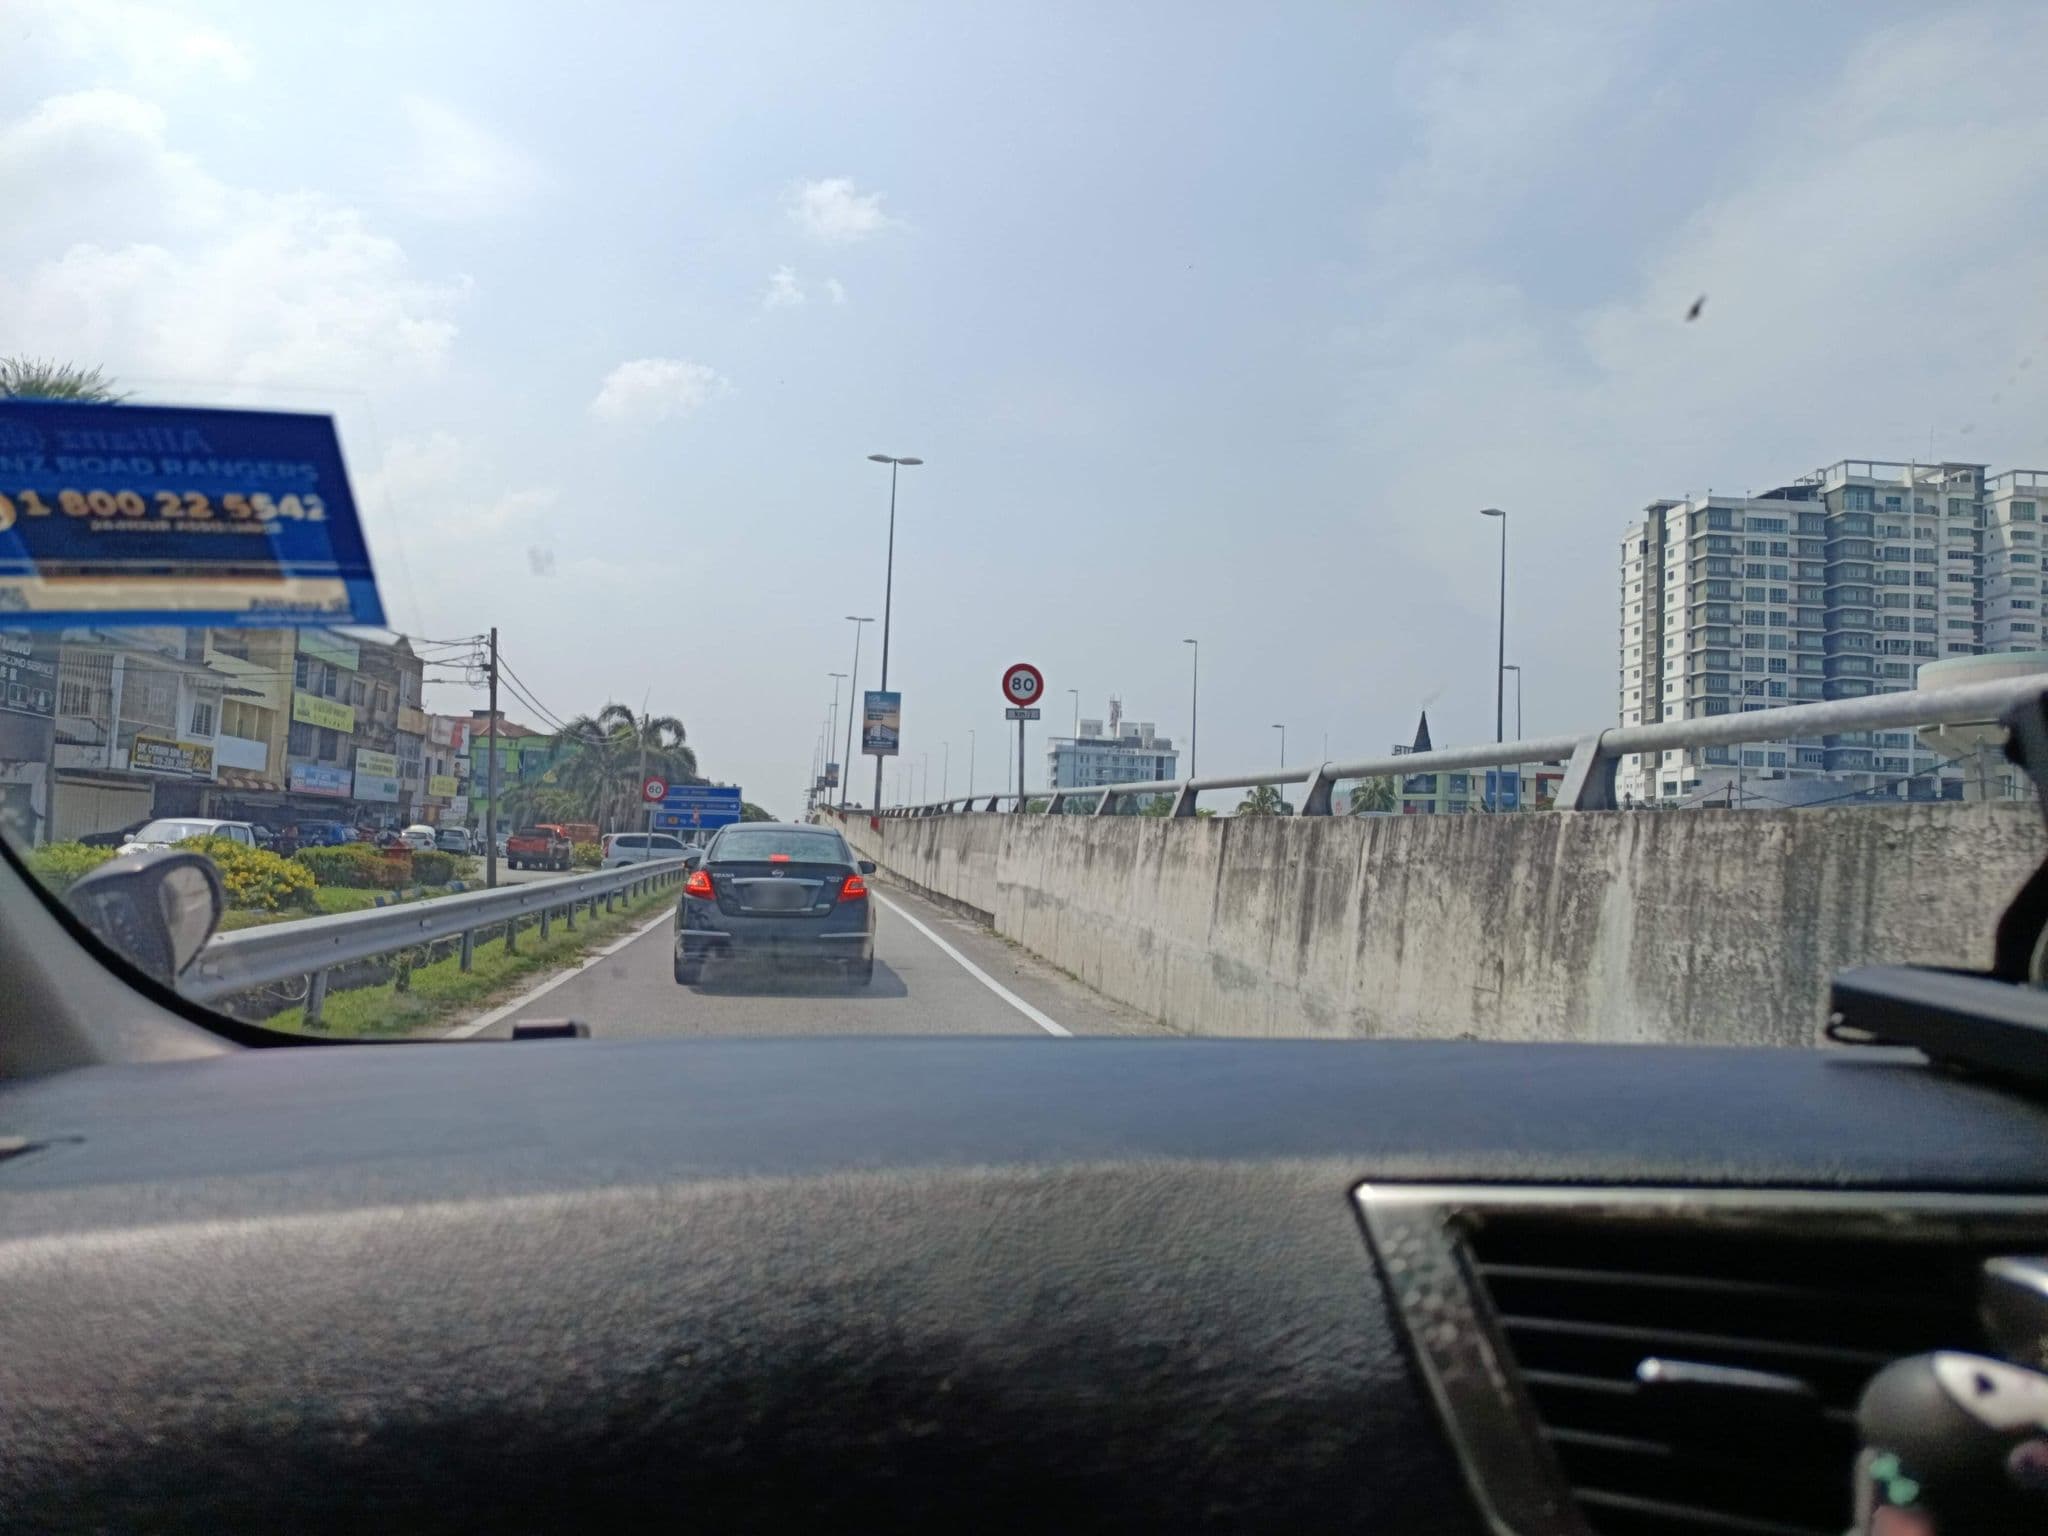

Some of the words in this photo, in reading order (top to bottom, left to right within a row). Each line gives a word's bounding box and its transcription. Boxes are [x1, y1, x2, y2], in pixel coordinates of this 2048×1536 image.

[55, 456, 155, 476] ROAD
[18, 490, 51, 516] 1
[58, 489, 147, 518] 800
[154, 490, 214, 519] 22
[222, 492, 327, 522] 5542
[1012, 677, 1034, 692] 80
